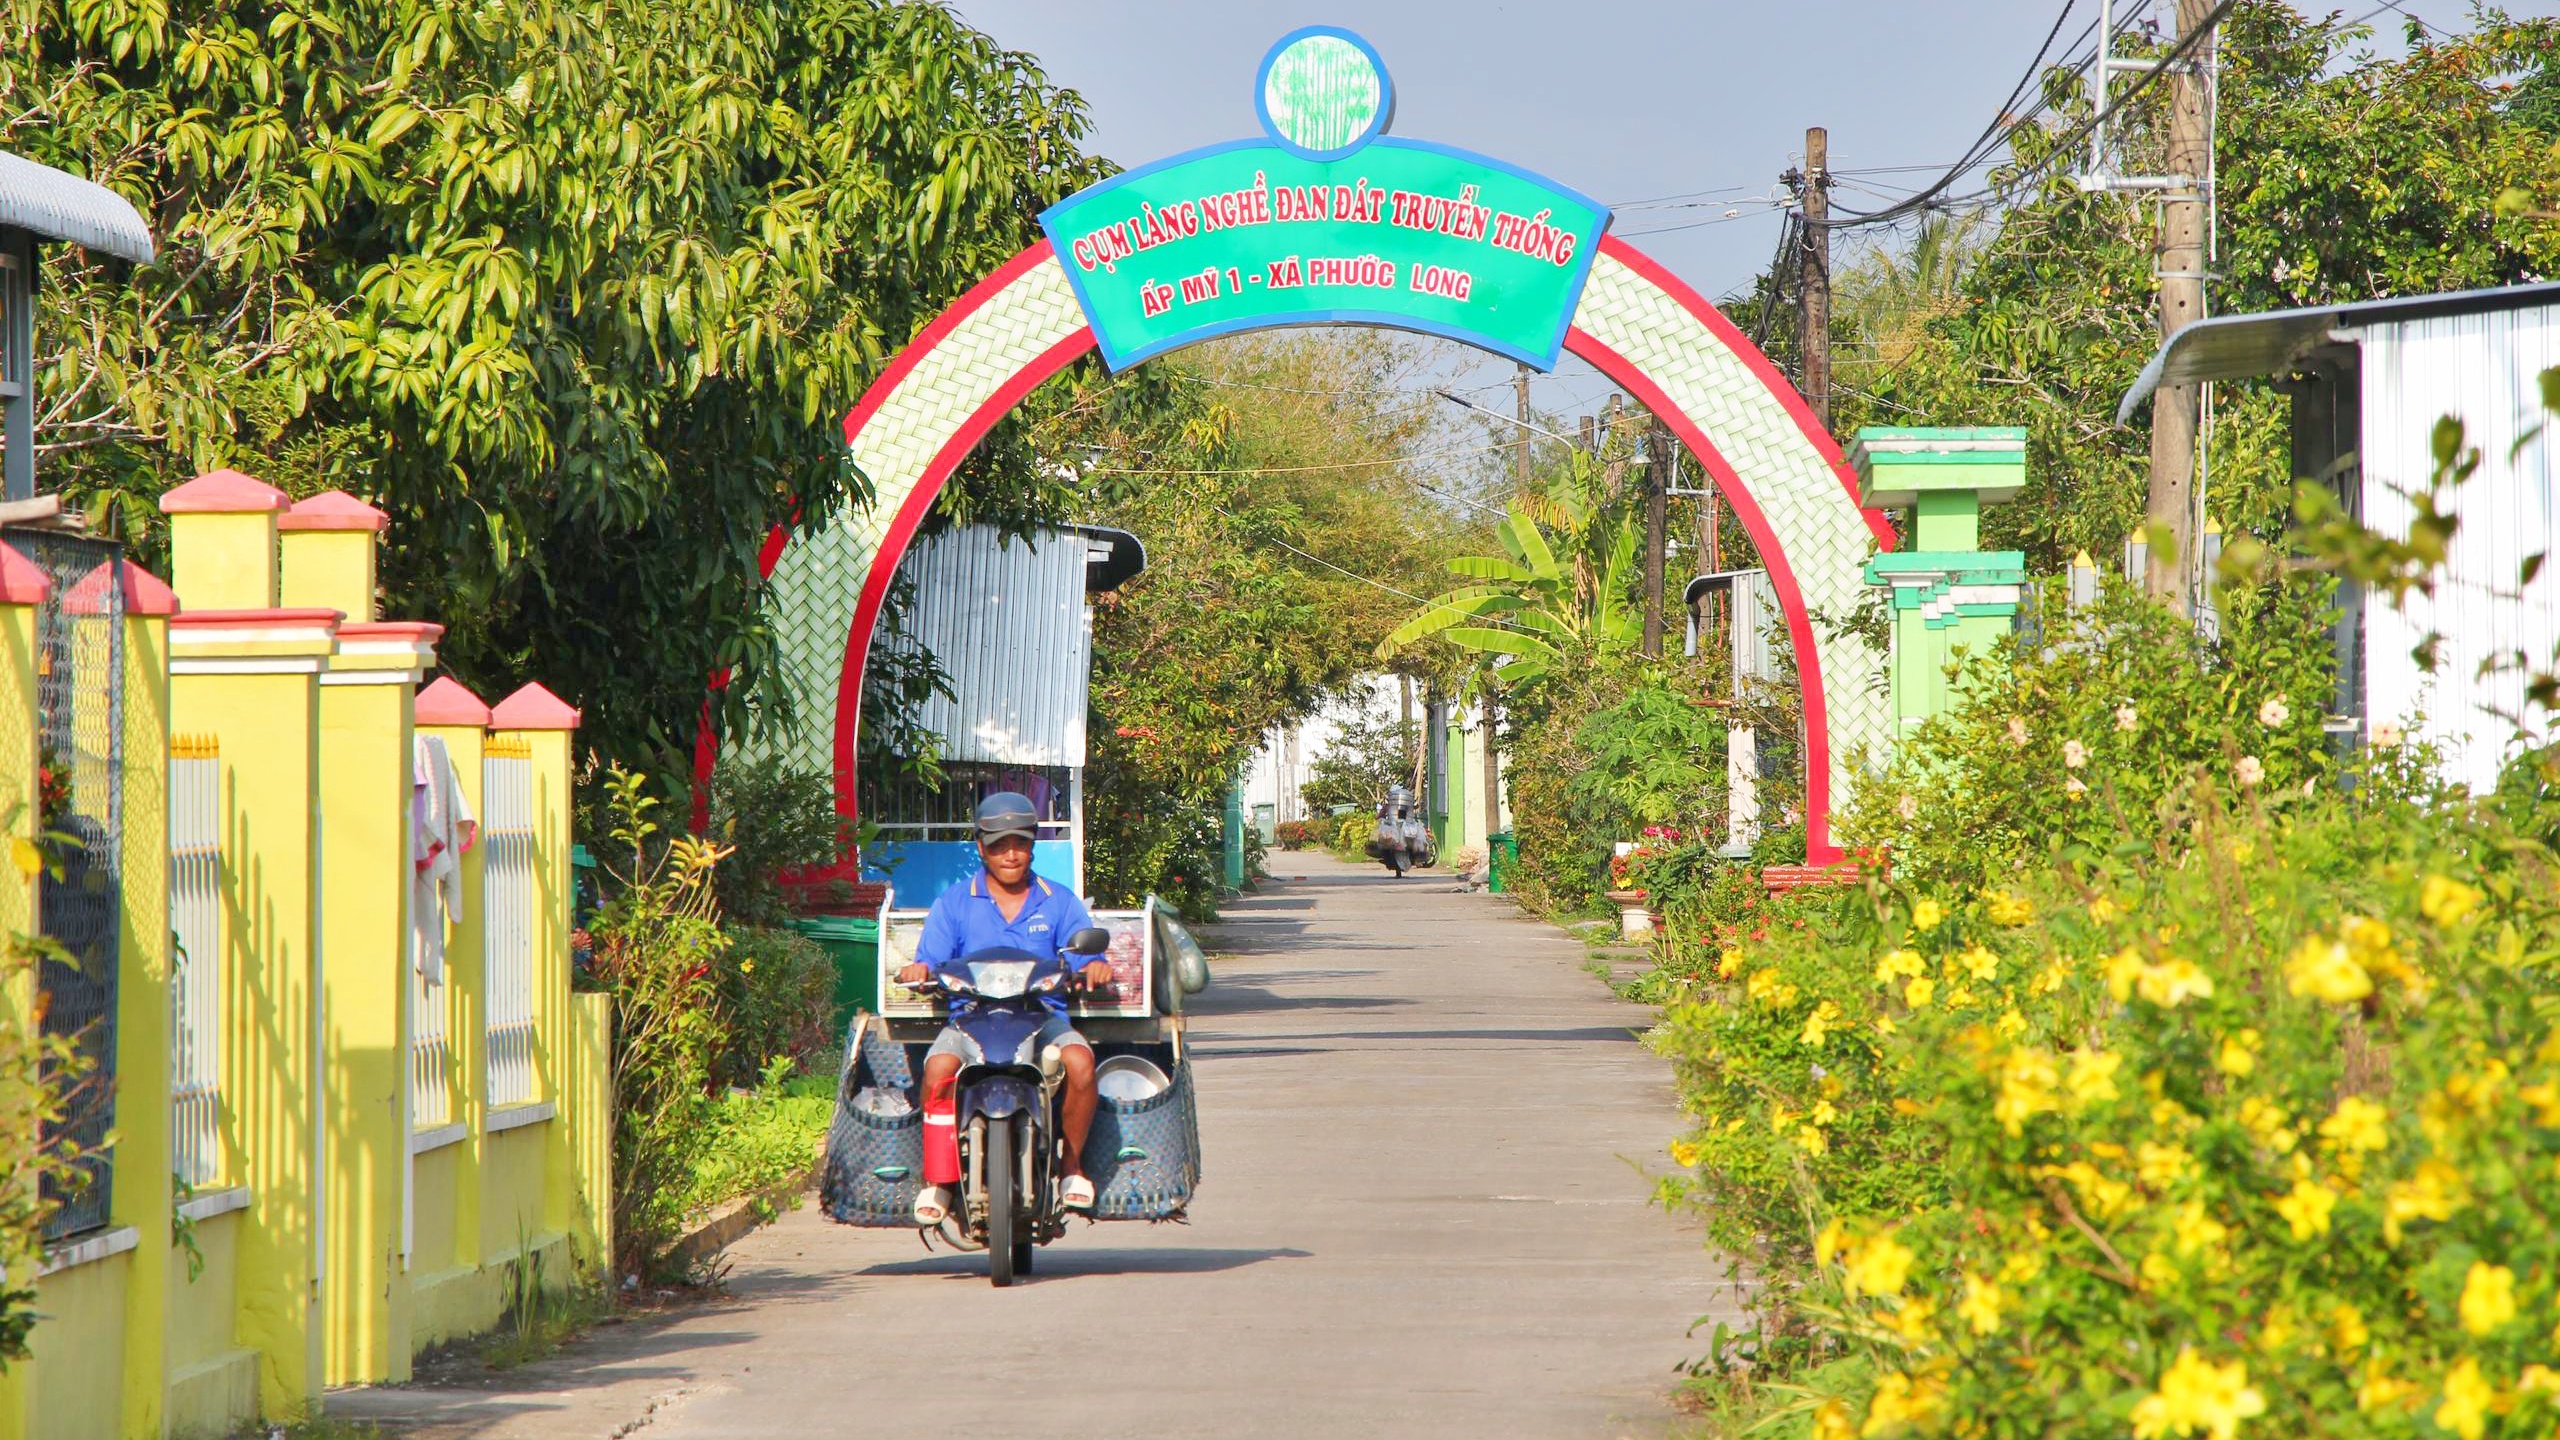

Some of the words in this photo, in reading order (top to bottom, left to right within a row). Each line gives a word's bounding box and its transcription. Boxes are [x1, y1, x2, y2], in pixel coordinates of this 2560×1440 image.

[1073, 223, 1132, 273] CỤM
[1128, 202, 1197, 250] LÀNG
[1200, 170, 1270, 232] NGHỀ
[1275, 186, 1328, 221] ĐAN
[1391, 185, 1490, 241] TRUYỀN
[1491, 209, 1576, 266] THỐNG
[1140, 278, 1174, 318] ẤP
[1180, 267, 1219, 305] MỸ
[1226, 267, 1242, 294] 1
[1249, 274, 1261, 283] -
[1267, 255, 1303, 289] XÃ
[1308, 254, 1395, 287] PHƯỚC
[1410, 263, 1471, 300] LONG
